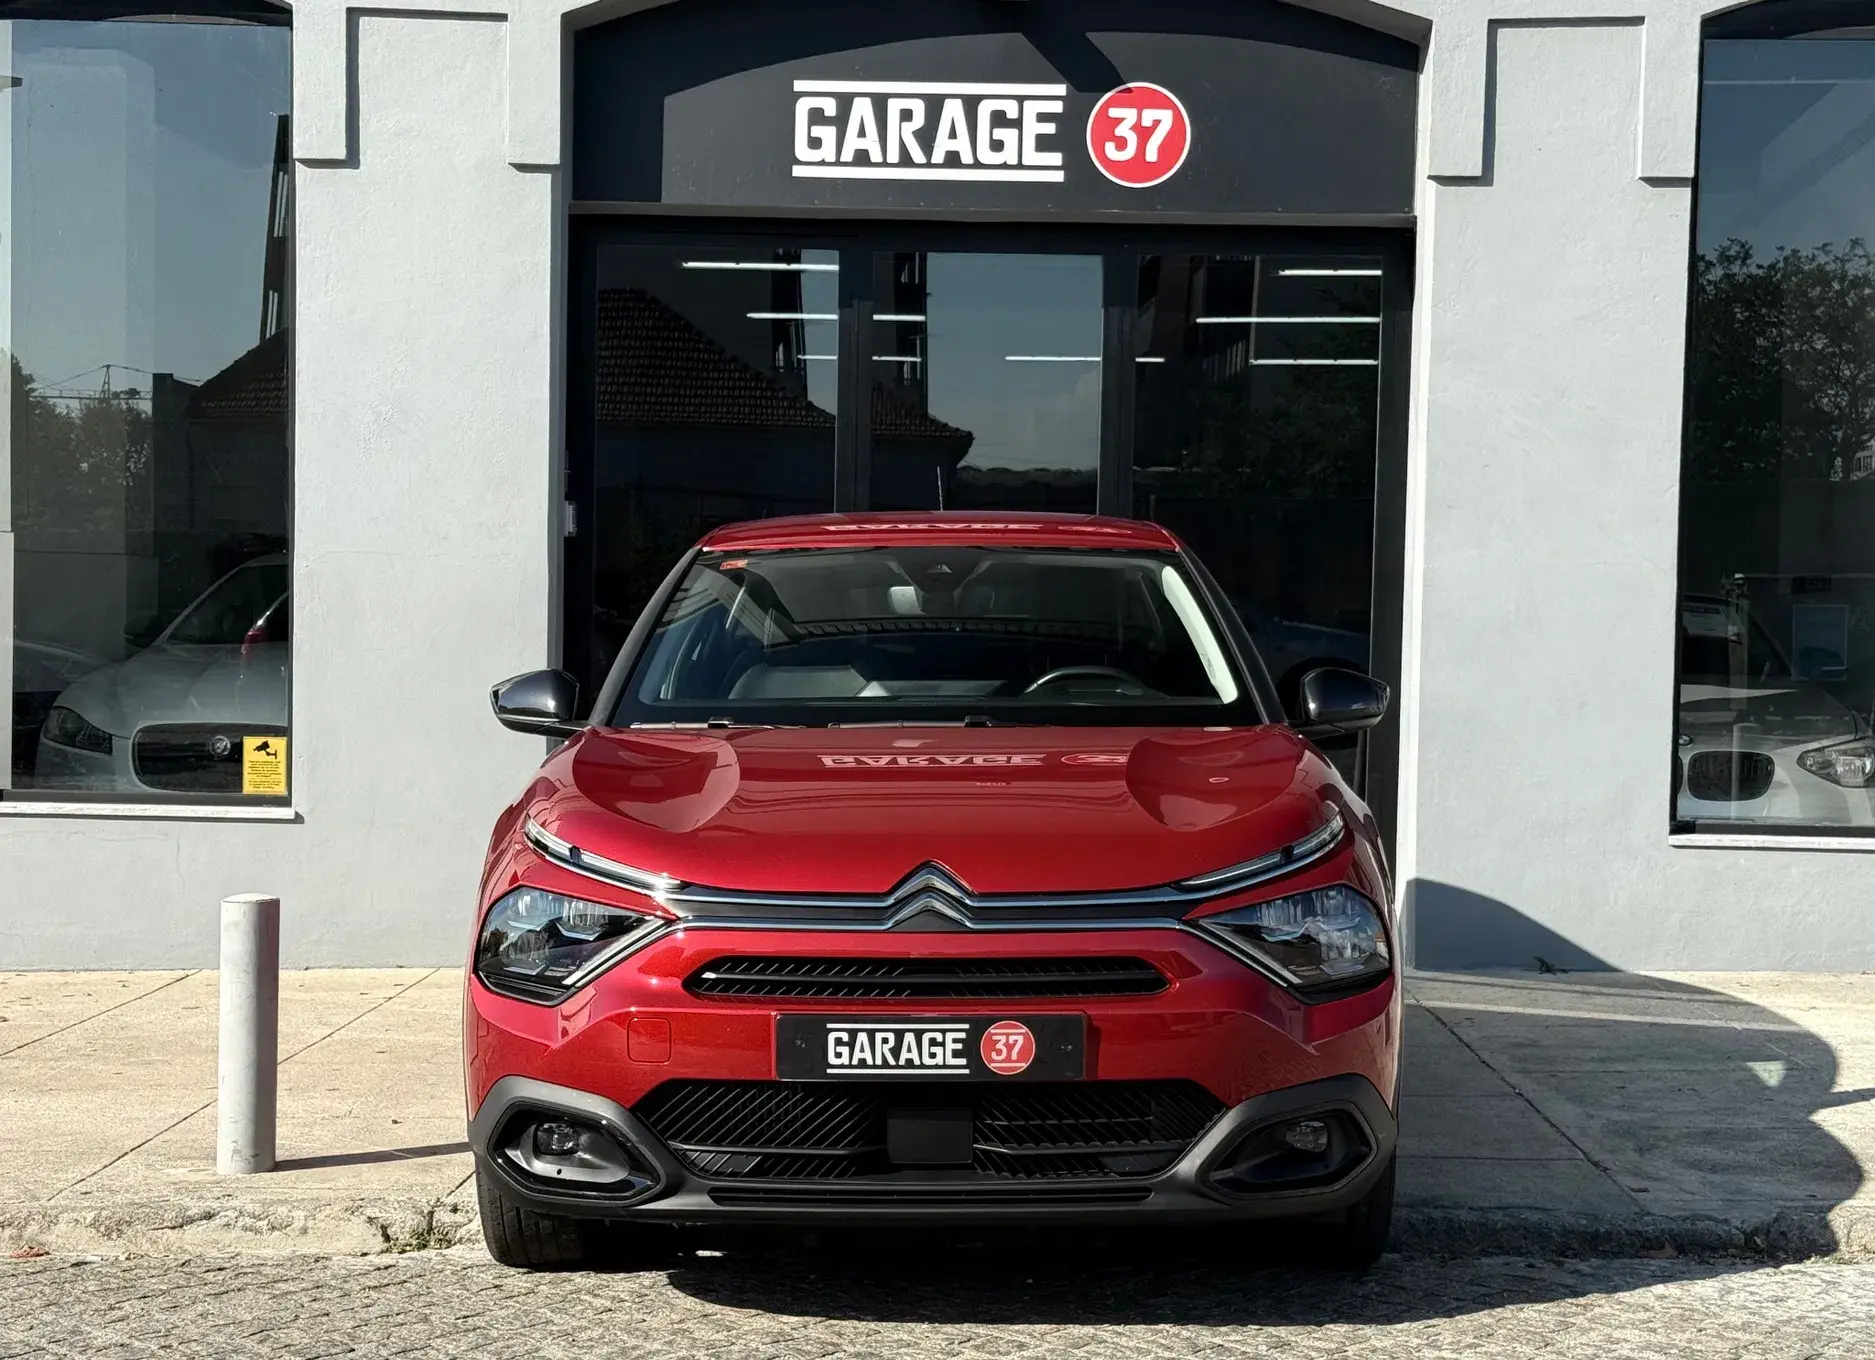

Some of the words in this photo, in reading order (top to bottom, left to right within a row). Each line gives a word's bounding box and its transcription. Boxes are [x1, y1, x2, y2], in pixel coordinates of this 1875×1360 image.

[794, 97, 1064, 166] GARAGE
[1104, 108, 1174, 162] 37
[827, 1031, 967, 1066] GARAGE
[991, 1034, 1024, 1061] 37
